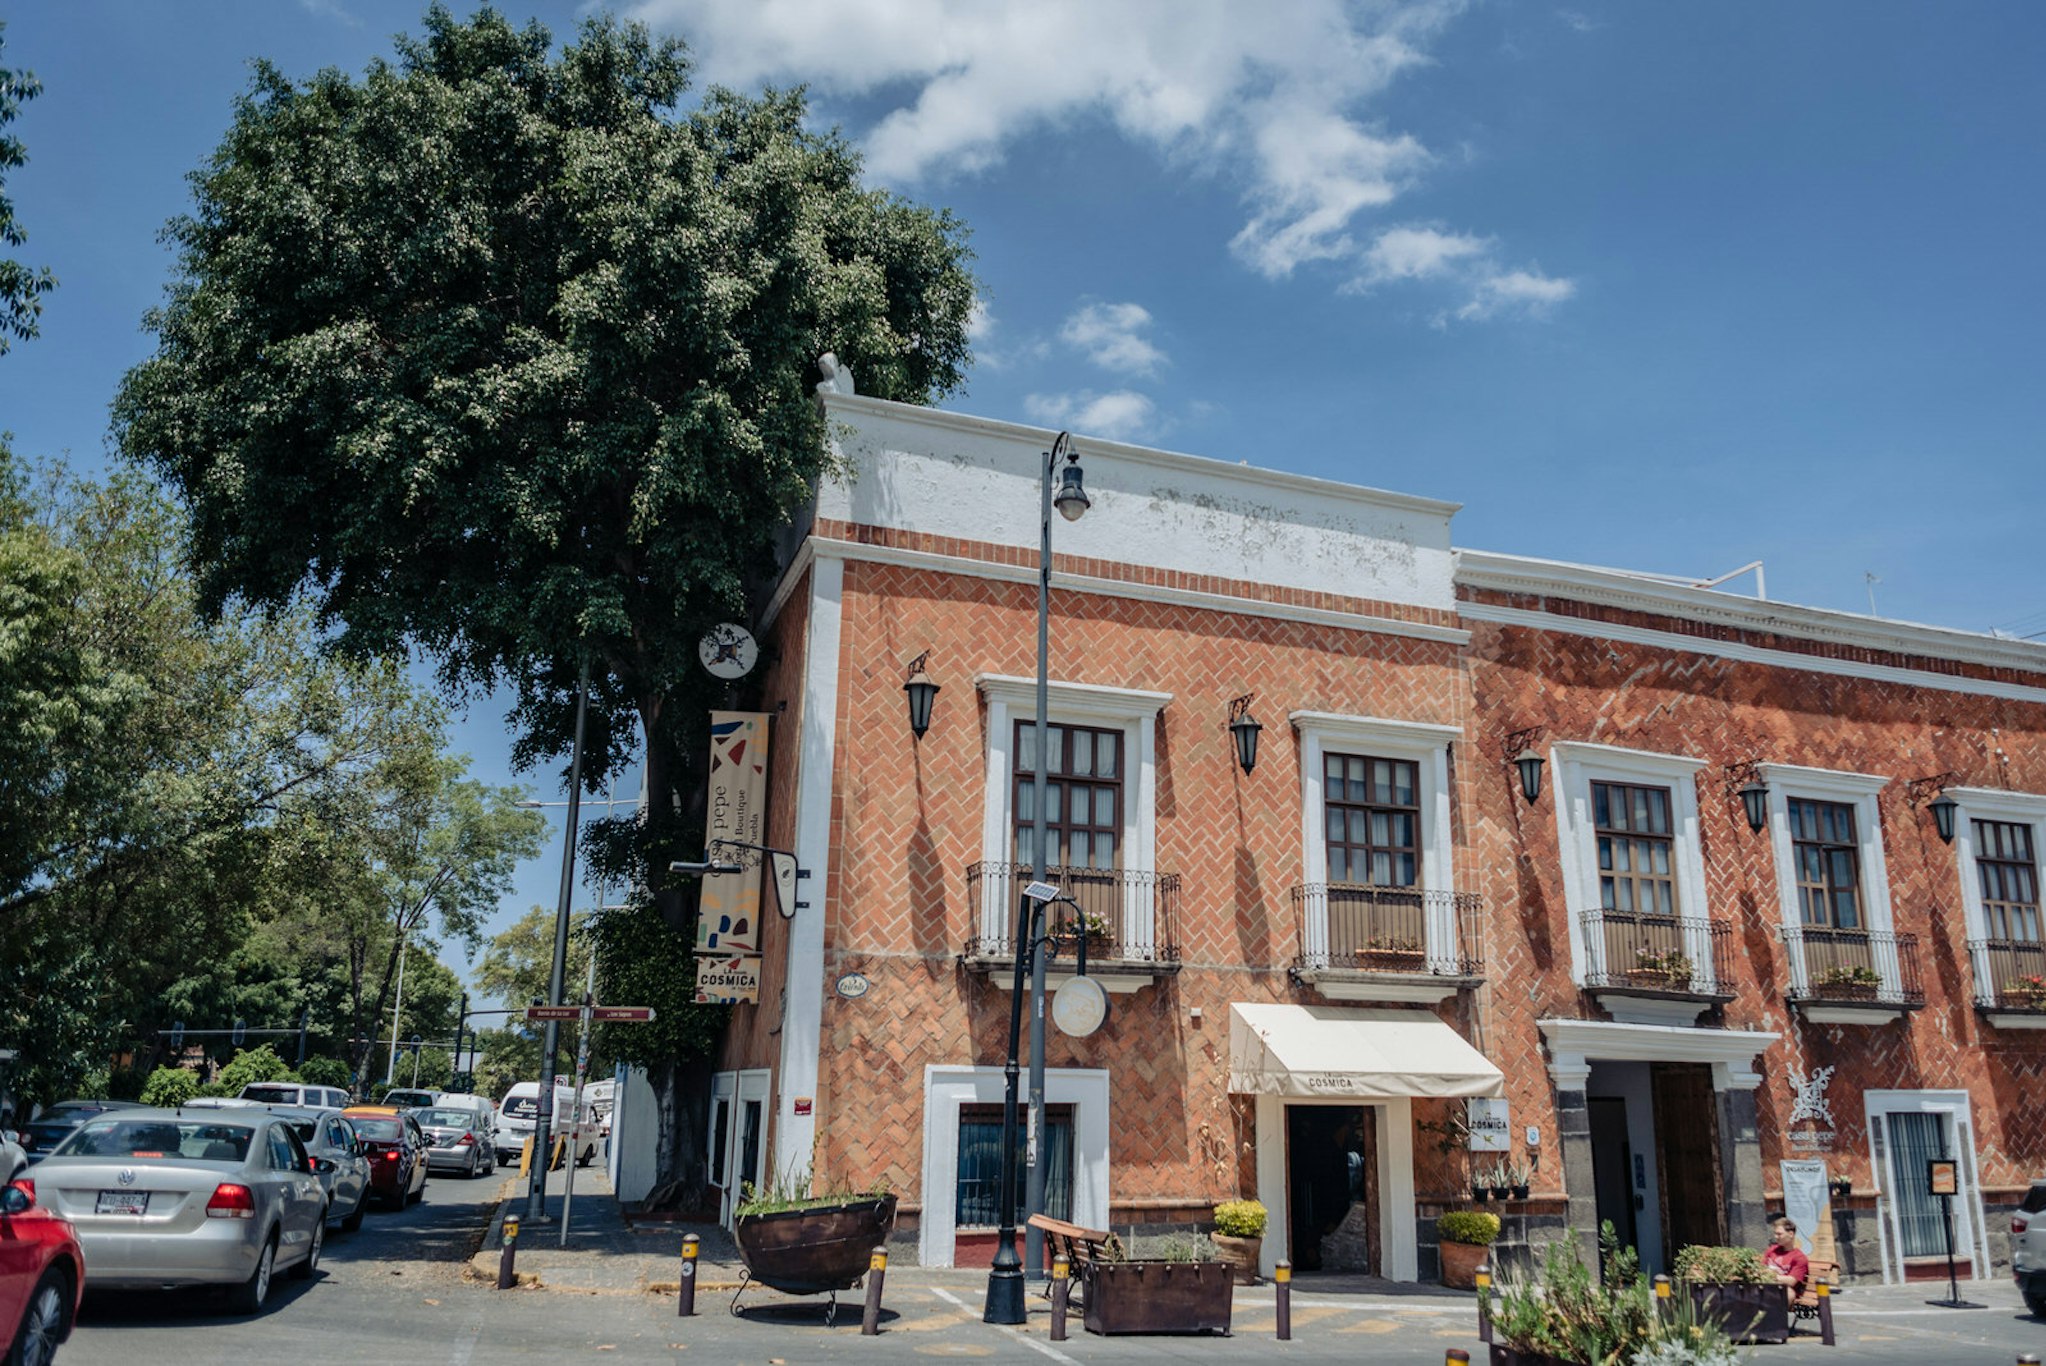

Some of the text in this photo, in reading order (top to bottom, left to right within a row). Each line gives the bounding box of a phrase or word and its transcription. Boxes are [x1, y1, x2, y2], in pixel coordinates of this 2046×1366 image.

[714, 785, 729, 830] pepe
[735, 788, 747, 836] Boutique
[701, 974, 756, 986] COSMICA
[1309, 1078, 1352, 1088] COSMICA
[1472, 1120, 1508, 1129] COSMICA
